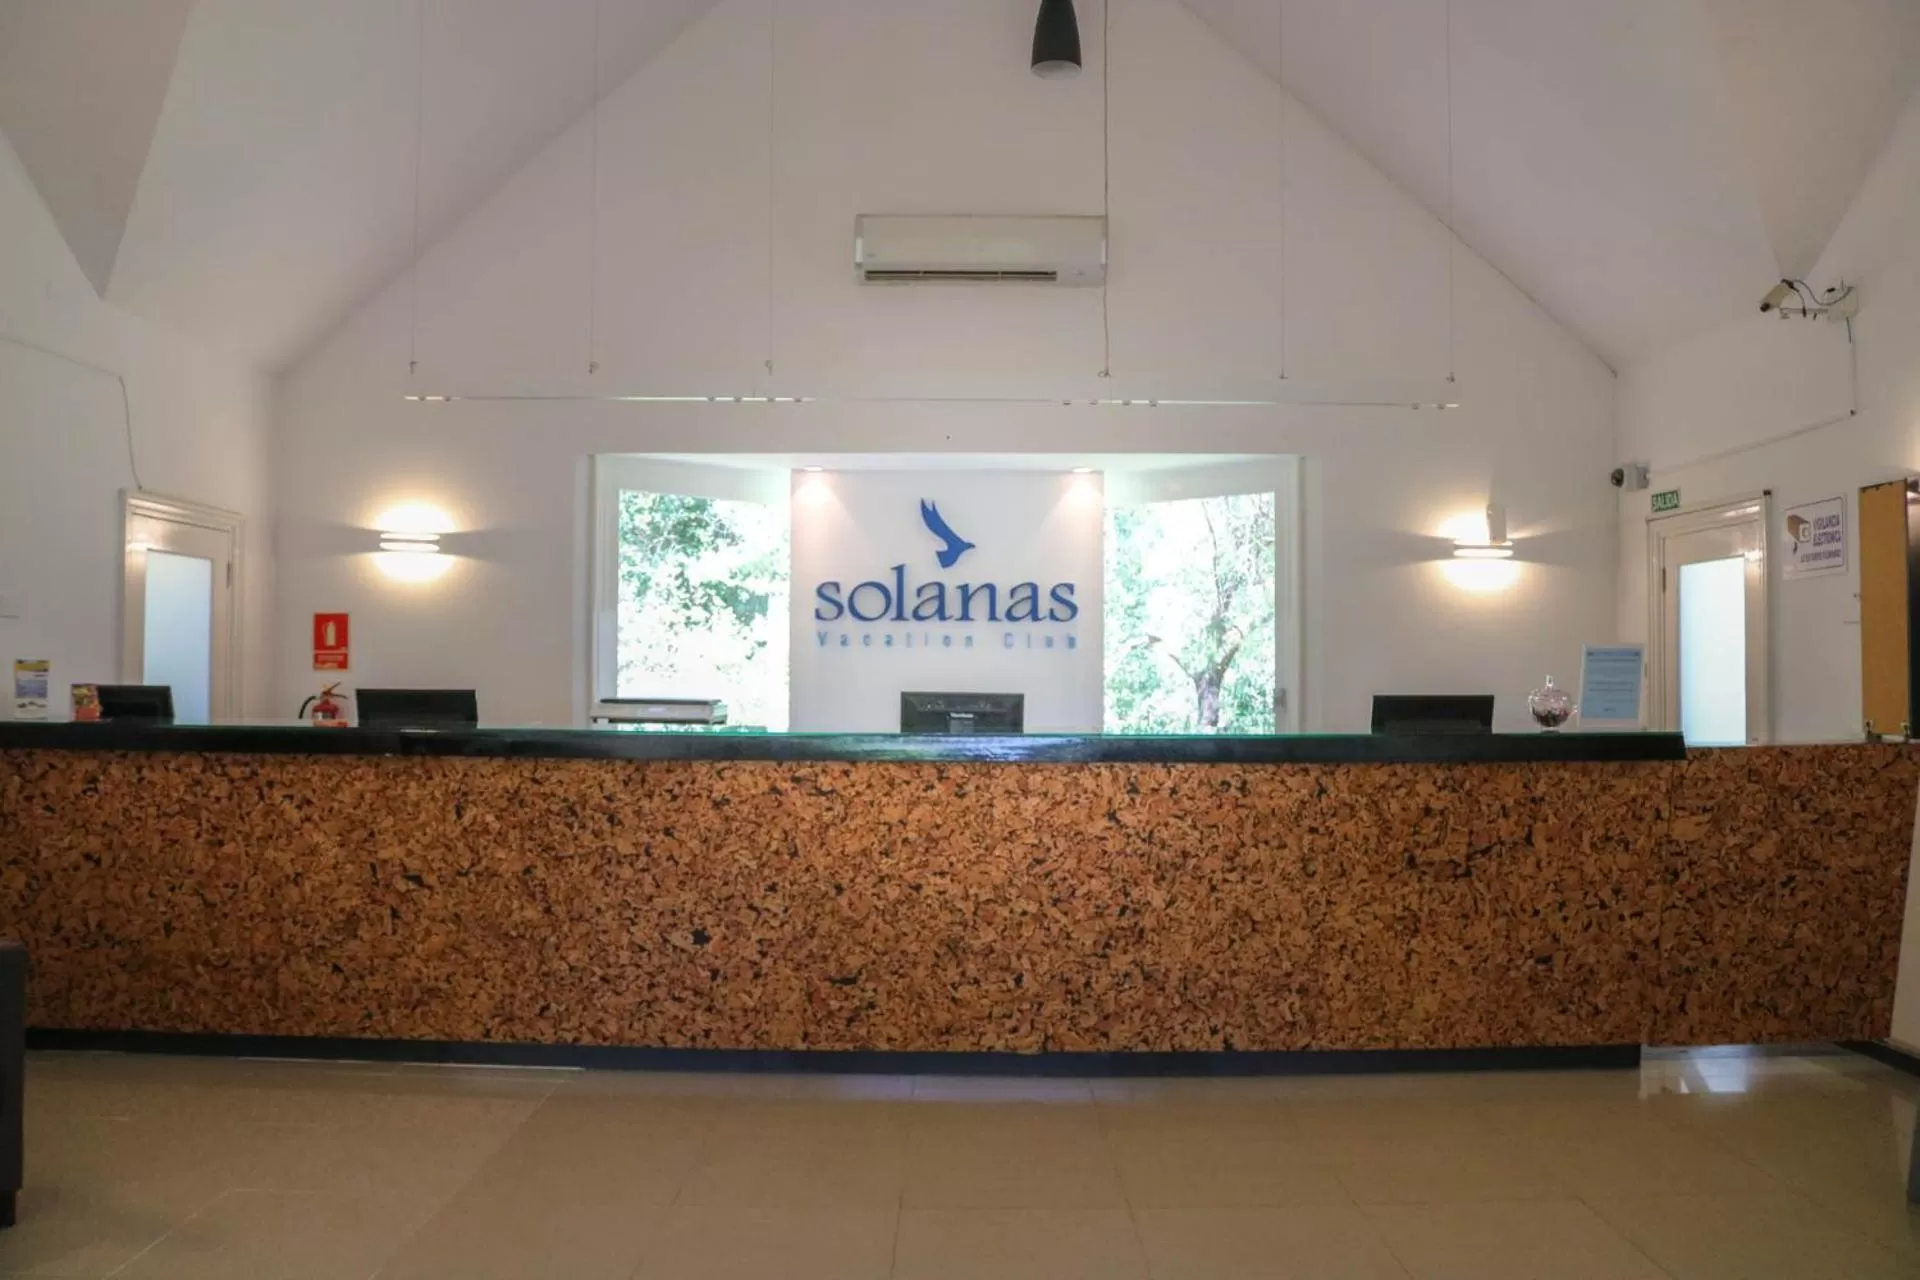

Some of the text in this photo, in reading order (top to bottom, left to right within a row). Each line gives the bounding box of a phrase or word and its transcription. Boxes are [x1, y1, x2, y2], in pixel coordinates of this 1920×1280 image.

[814, 564, 1079, 622] solanas
[816, 631, 1077, 649] Vacation Club
